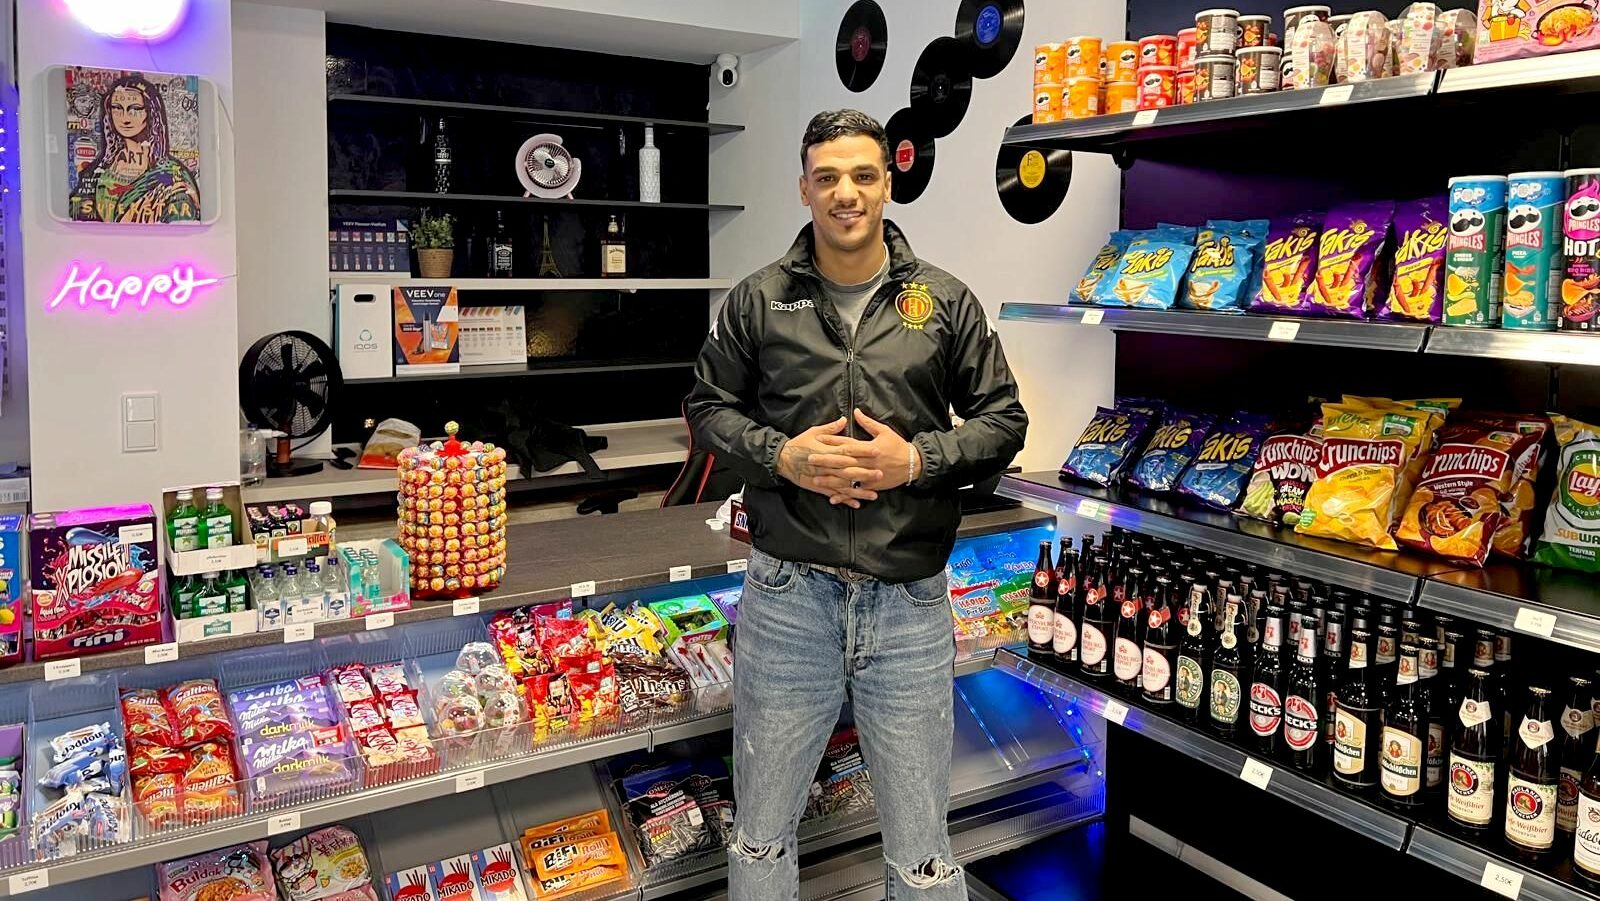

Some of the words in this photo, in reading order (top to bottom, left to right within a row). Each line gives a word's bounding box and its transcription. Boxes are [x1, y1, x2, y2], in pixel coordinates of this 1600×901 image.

[116, 152, 145, 166] ART
[82, 200, 192, 217] SUPERSTAR
[1568, 218, 1600, 232] PRINGLES
[1265, 231, 1318, 262] Takis
[1319, 228, 1375, 257] Takis
[1449, 233, 1484, 250] PRINGLES
[1507, 230, 1540, 248] PRINGLES
[1564, 237, 1600, 256] HOT
[51, 266, 218, 309] Happy
[406, 290, 434, 298] VEEV
[1319, 442, 1397, 472] Crunchips
[1270, 461, 1318, 482] WOW
[1555, 528, 1600, 544] SUBWA
[68, 541, 124, 569] MISSILE
[959, 596, 992, 608] HARIBO
[260, 718, 315, 736] darkmilk
[254, 737, 309, 759] Milka
[273, 756, 329, 774] darkmilk
[1452, 762, 1477, 780] PAULANER
[1512, 785, 1541, 803] PAULANER
[1512, 805, 1538, 820] MÜNCHEN
[544, 846, 578, 869] BiFi
[169, 868, 222, 893] Buldak
[481, 869, 517, 886] MIKADO
[438, 881, 475, 898] MIKADO
